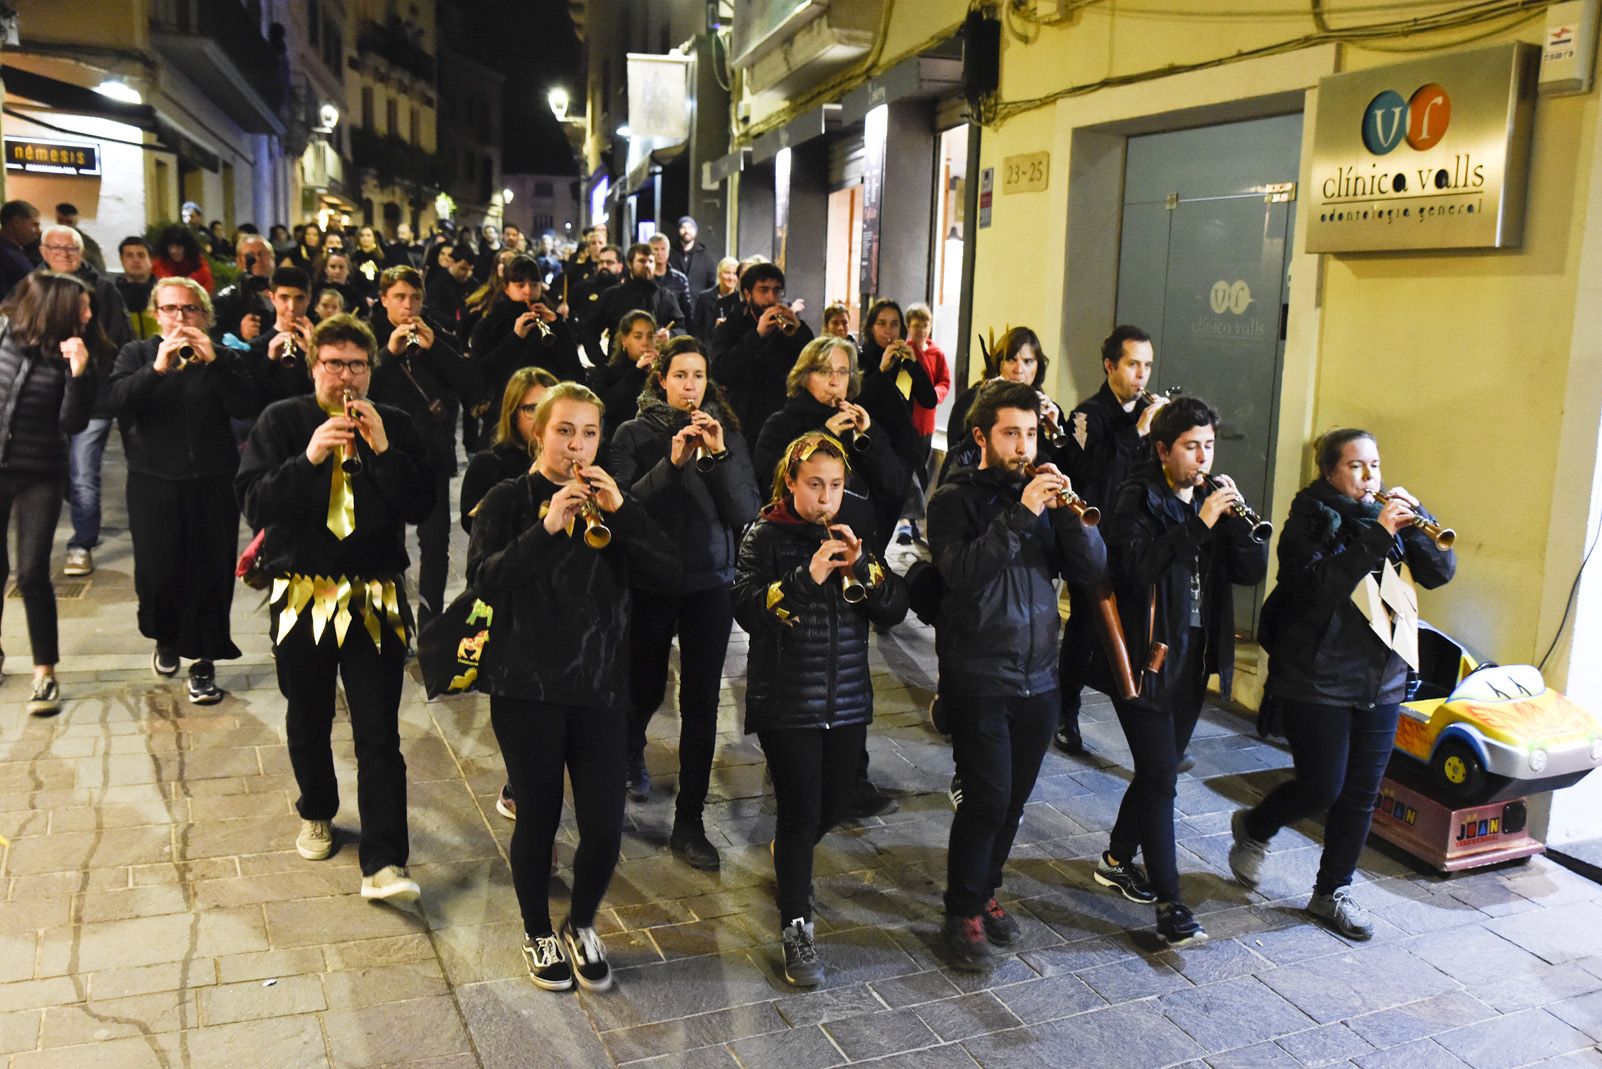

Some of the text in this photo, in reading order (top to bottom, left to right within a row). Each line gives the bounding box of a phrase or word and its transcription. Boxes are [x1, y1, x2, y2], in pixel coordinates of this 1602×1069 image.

[1322, 154, 1485, 199] clínica valls
[1418, 198, 1483, 223] general
[1456, 816, 1500, 841] JOAN
